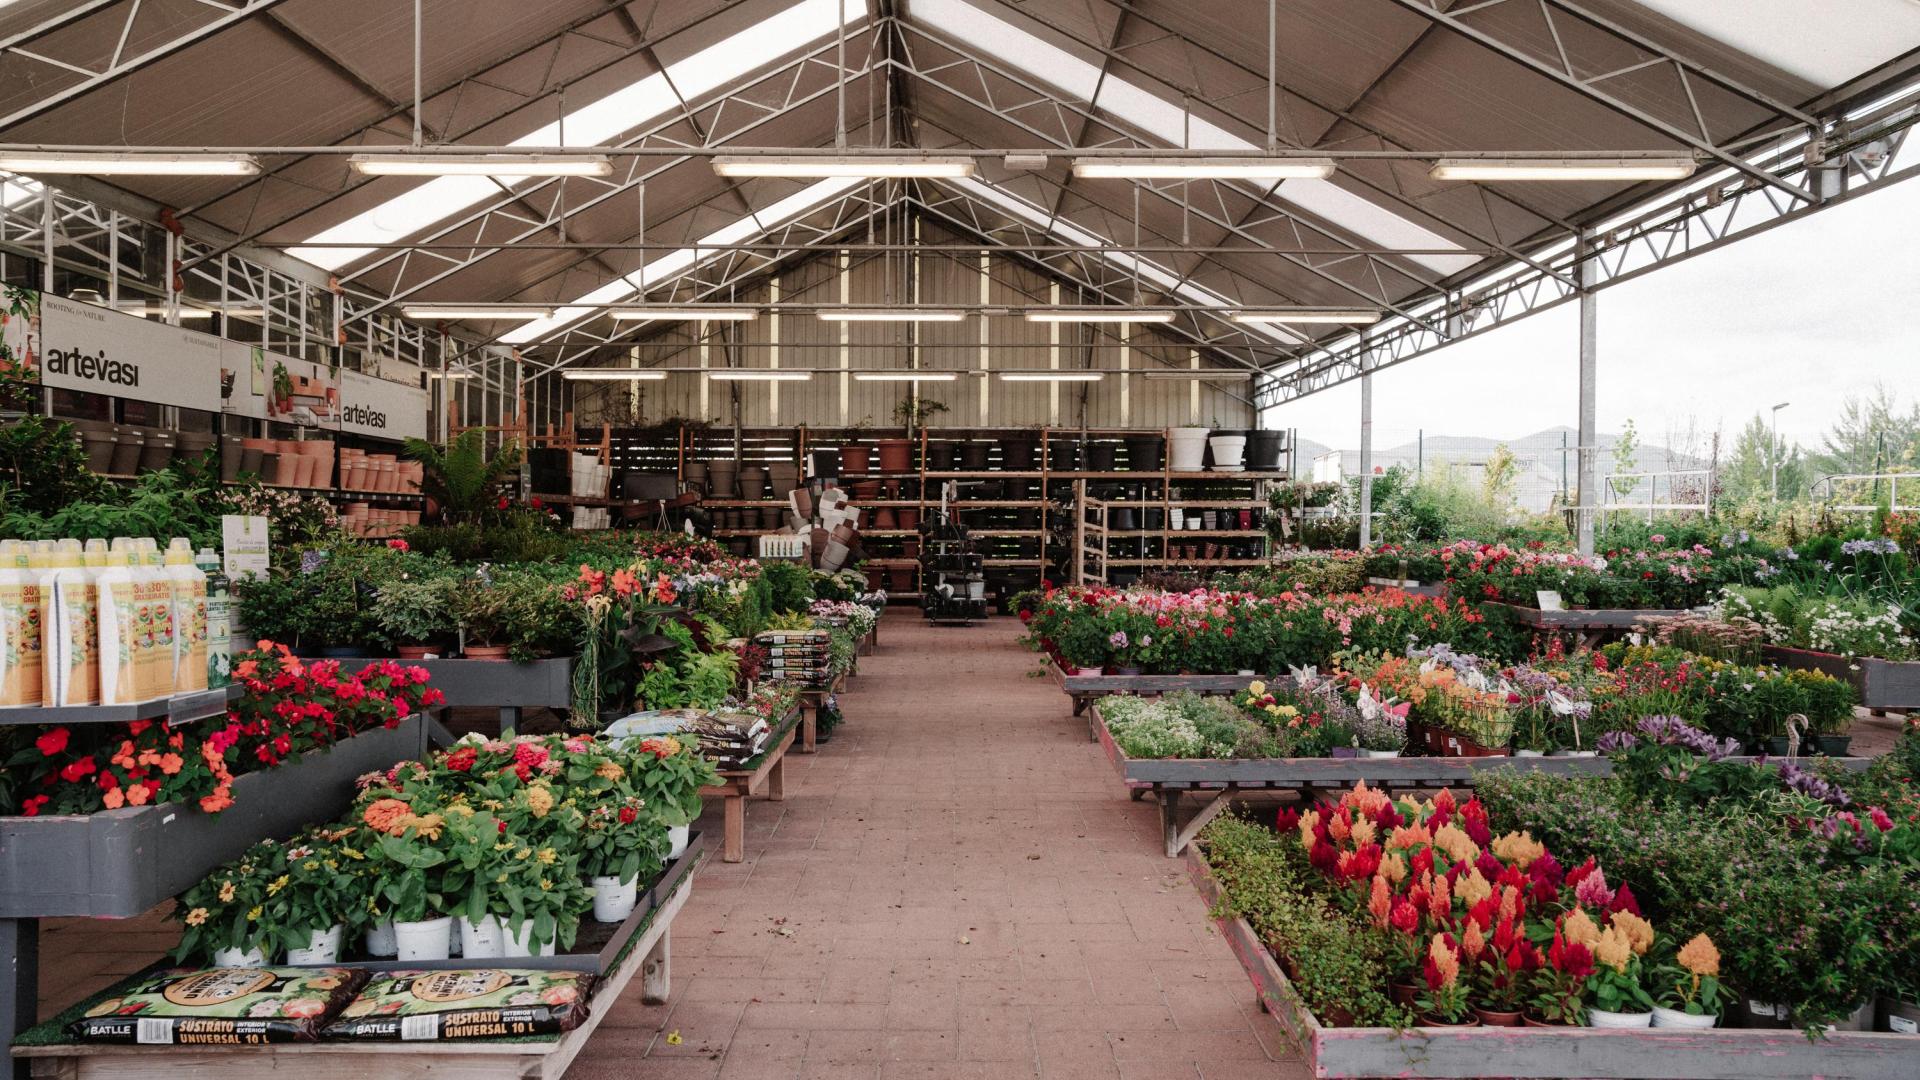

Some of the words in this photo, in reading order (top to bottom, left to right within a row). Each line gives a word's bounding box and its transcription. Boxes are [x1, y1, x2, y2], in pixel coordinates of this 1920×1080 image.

[47, 345, 139, 387] artevasi
[343, 403, 386, 428] artevasi
[446, 1011, 499, 1026] SUSTRATO
[90, 1025, 131, 1035] BATLLE
[179, 1020, 234, 1033] SUSTRATO
[356, 1024, 396, 1035] BATLLE
[445, 1023, 507, 1038] UNIVERSAL
[512, 1022, 525, 1034] 10
[529, 1022, 535, 1032] L
[180, 1033, 241, 1044] UNIVERSAL
[245, 1034, 259, 1044] 10
[263, 1034, 269, 1044] L
